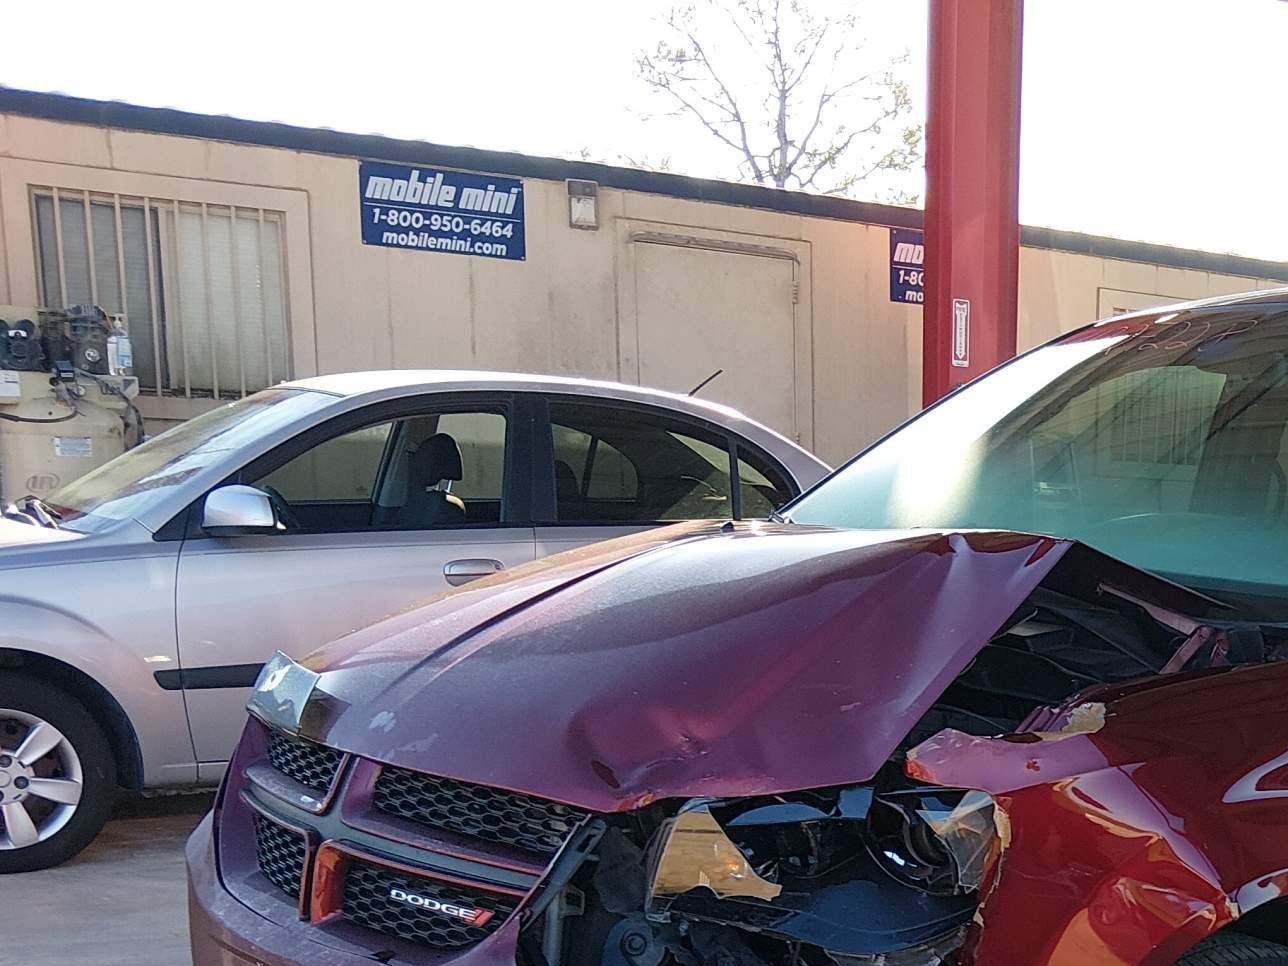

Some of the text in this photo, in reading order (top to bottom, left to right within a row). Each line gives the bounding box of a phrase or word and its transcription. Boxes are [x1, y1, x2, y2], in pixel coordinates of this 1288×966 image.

[365, 170, 518, 214] mobile mini
[373, 208, 513, 238] 1-800-950-6464
[382, 231, 507, 256] mobilemini.com
[390, 889, 477, 921] DODGE
